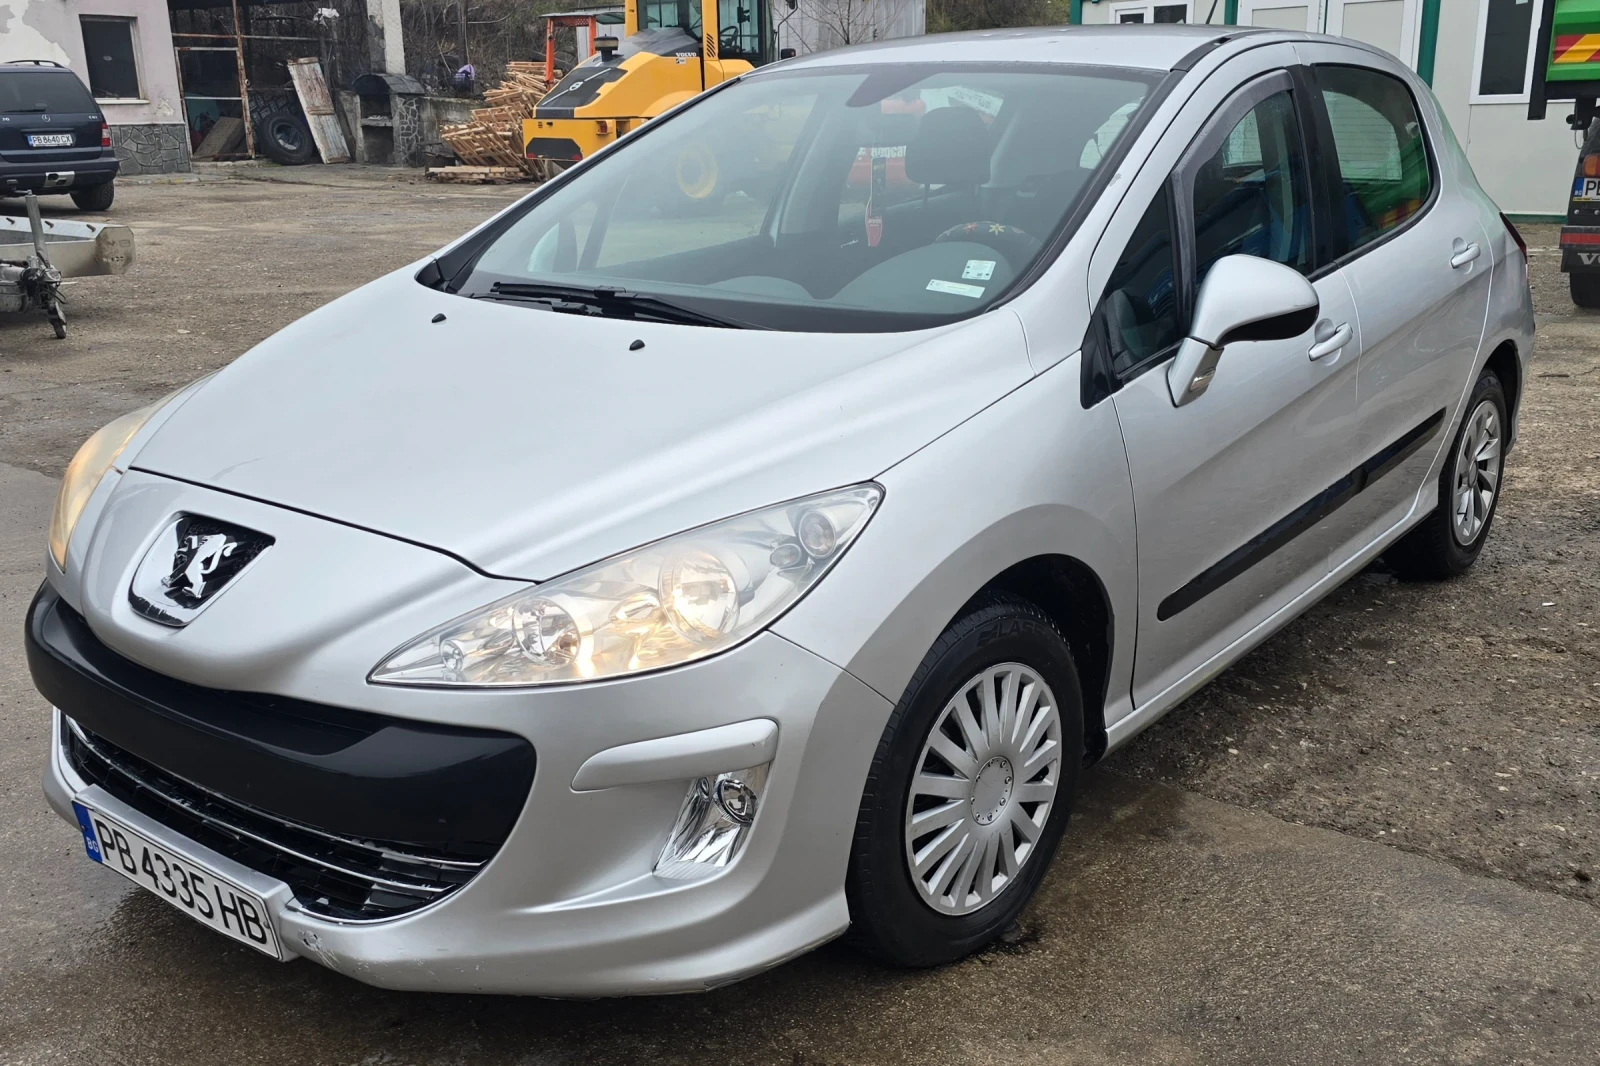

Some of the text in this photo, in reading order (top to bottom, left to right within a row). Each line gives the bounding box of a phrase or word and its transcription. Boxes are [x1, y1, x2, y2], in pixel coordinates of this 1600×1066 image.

[1577, 252, 1600, 265] V
[87, 837, 99, 853] BG
[94, 818, 267, 945] PB 4335 HB
